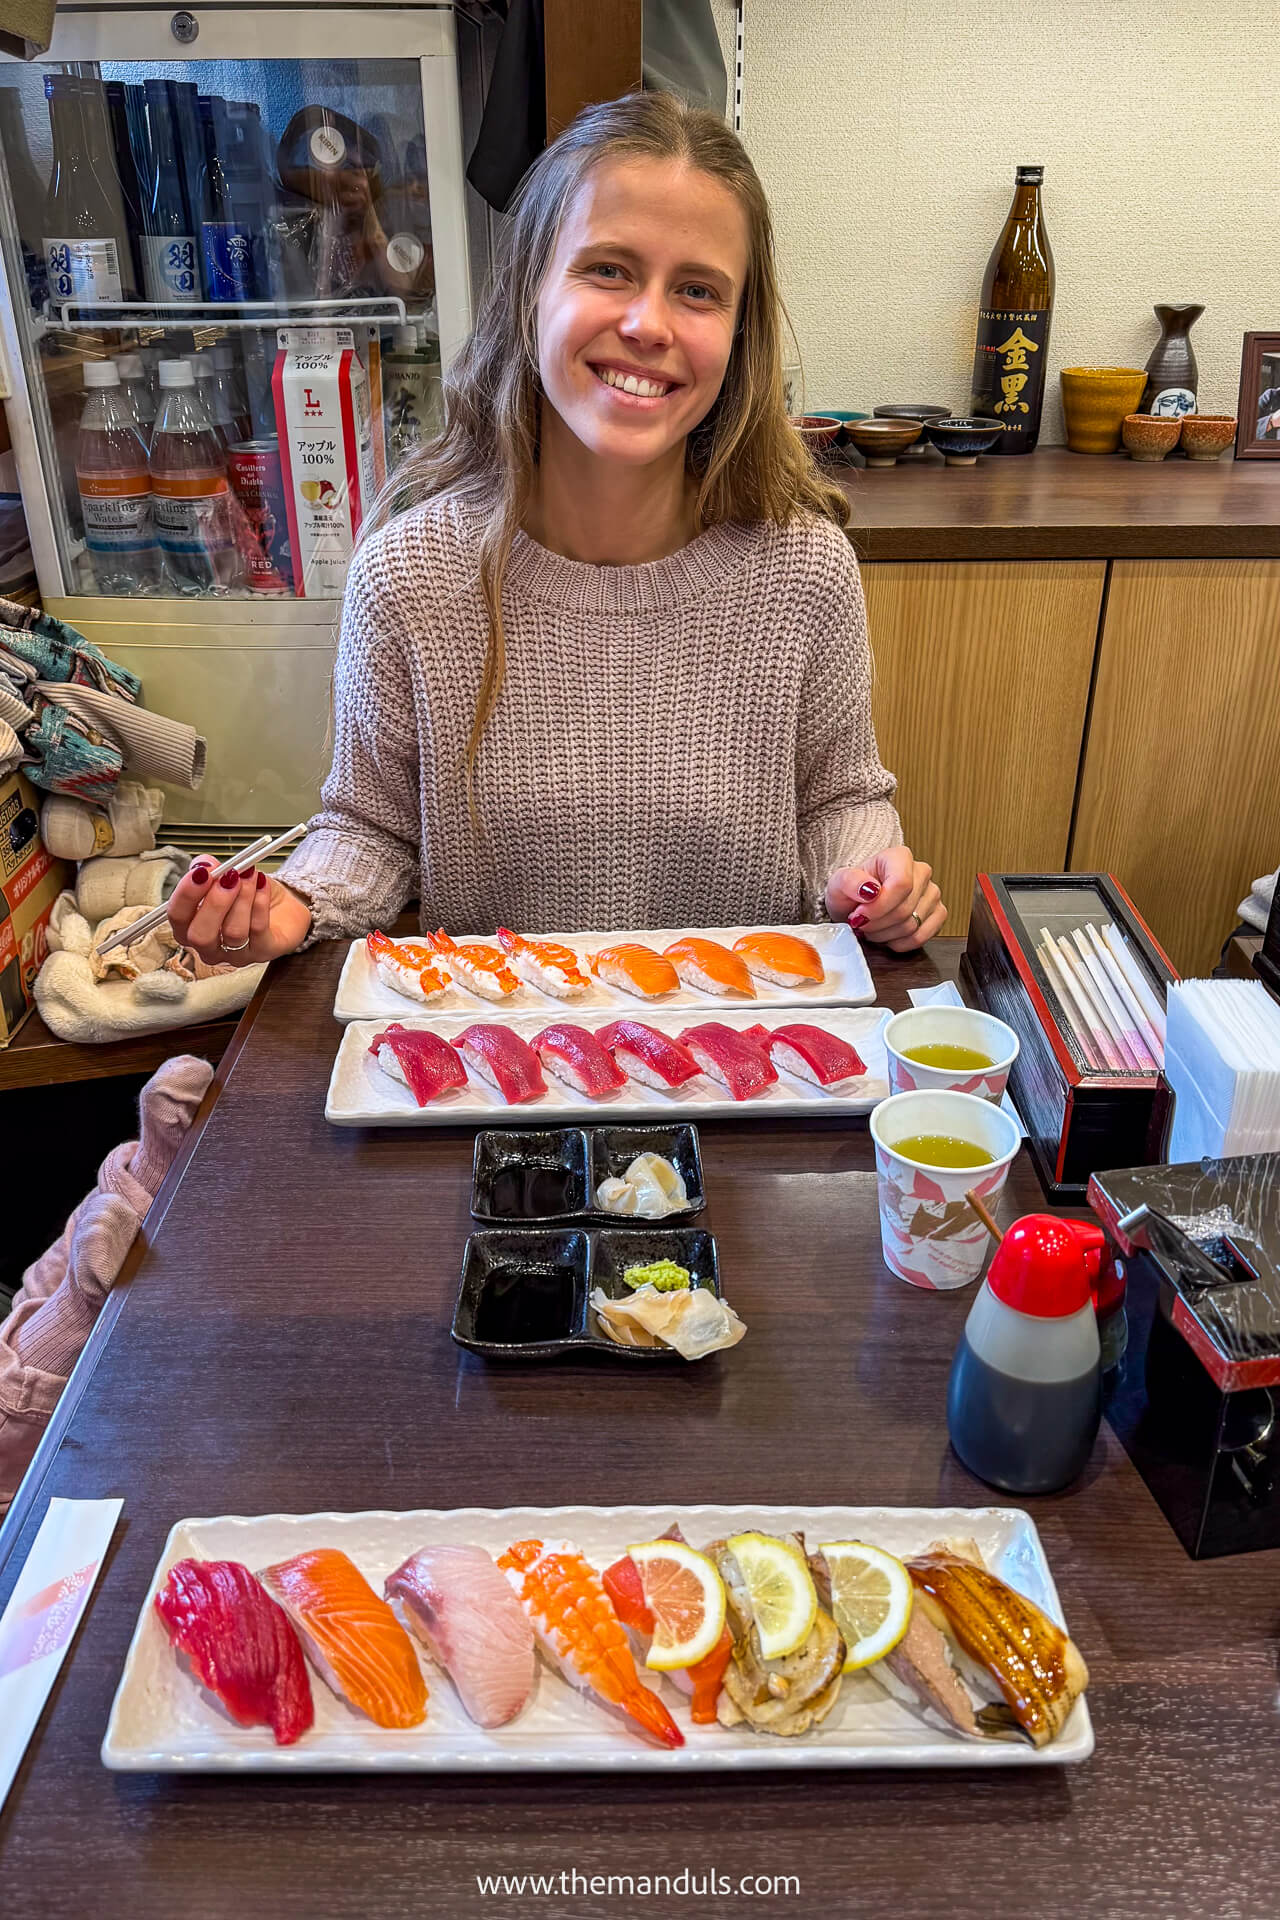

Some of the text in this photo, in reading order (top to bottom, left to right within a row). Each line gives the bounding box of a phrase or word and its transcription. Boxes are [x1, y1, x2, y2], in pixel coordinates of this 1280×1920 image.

[318, 133, 338, 156] KIRIN
[295, 354, 334, 362] アップル
[295, 362, 328, 370] 100%
[994, 326, 1039, 414] 金黒
[304, 389, 320, 408] L
[297, 440, 336, 452] アップル
[302, 454, 334, 465] 100%
[93, 512, 124, 523] Water
[251, 561, 273, 569] RED
